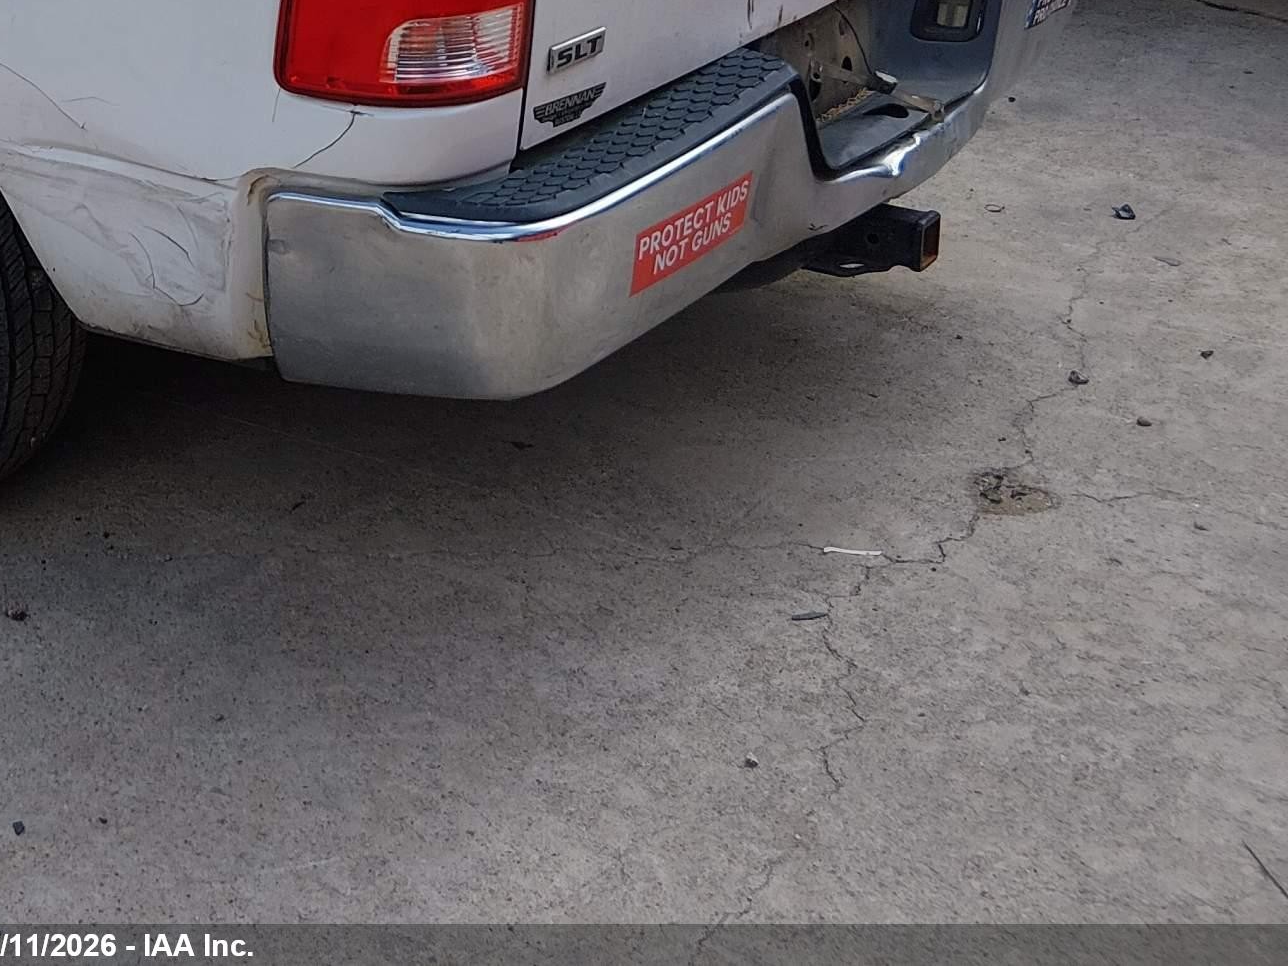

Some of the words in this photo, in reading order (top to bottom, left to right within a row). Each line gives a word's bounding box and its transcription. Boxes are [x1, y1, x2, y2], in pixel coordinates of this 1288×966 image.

[556, 35, 603, 68] SLT
[544, 89, 597, 116] BRENNAN
[638, 200, 715, 260] PROTECT
[716, 180, 750, 217] KIDS
[652, 238, 690, 275] NOT
[691, 212, 732, 252] GUNS
